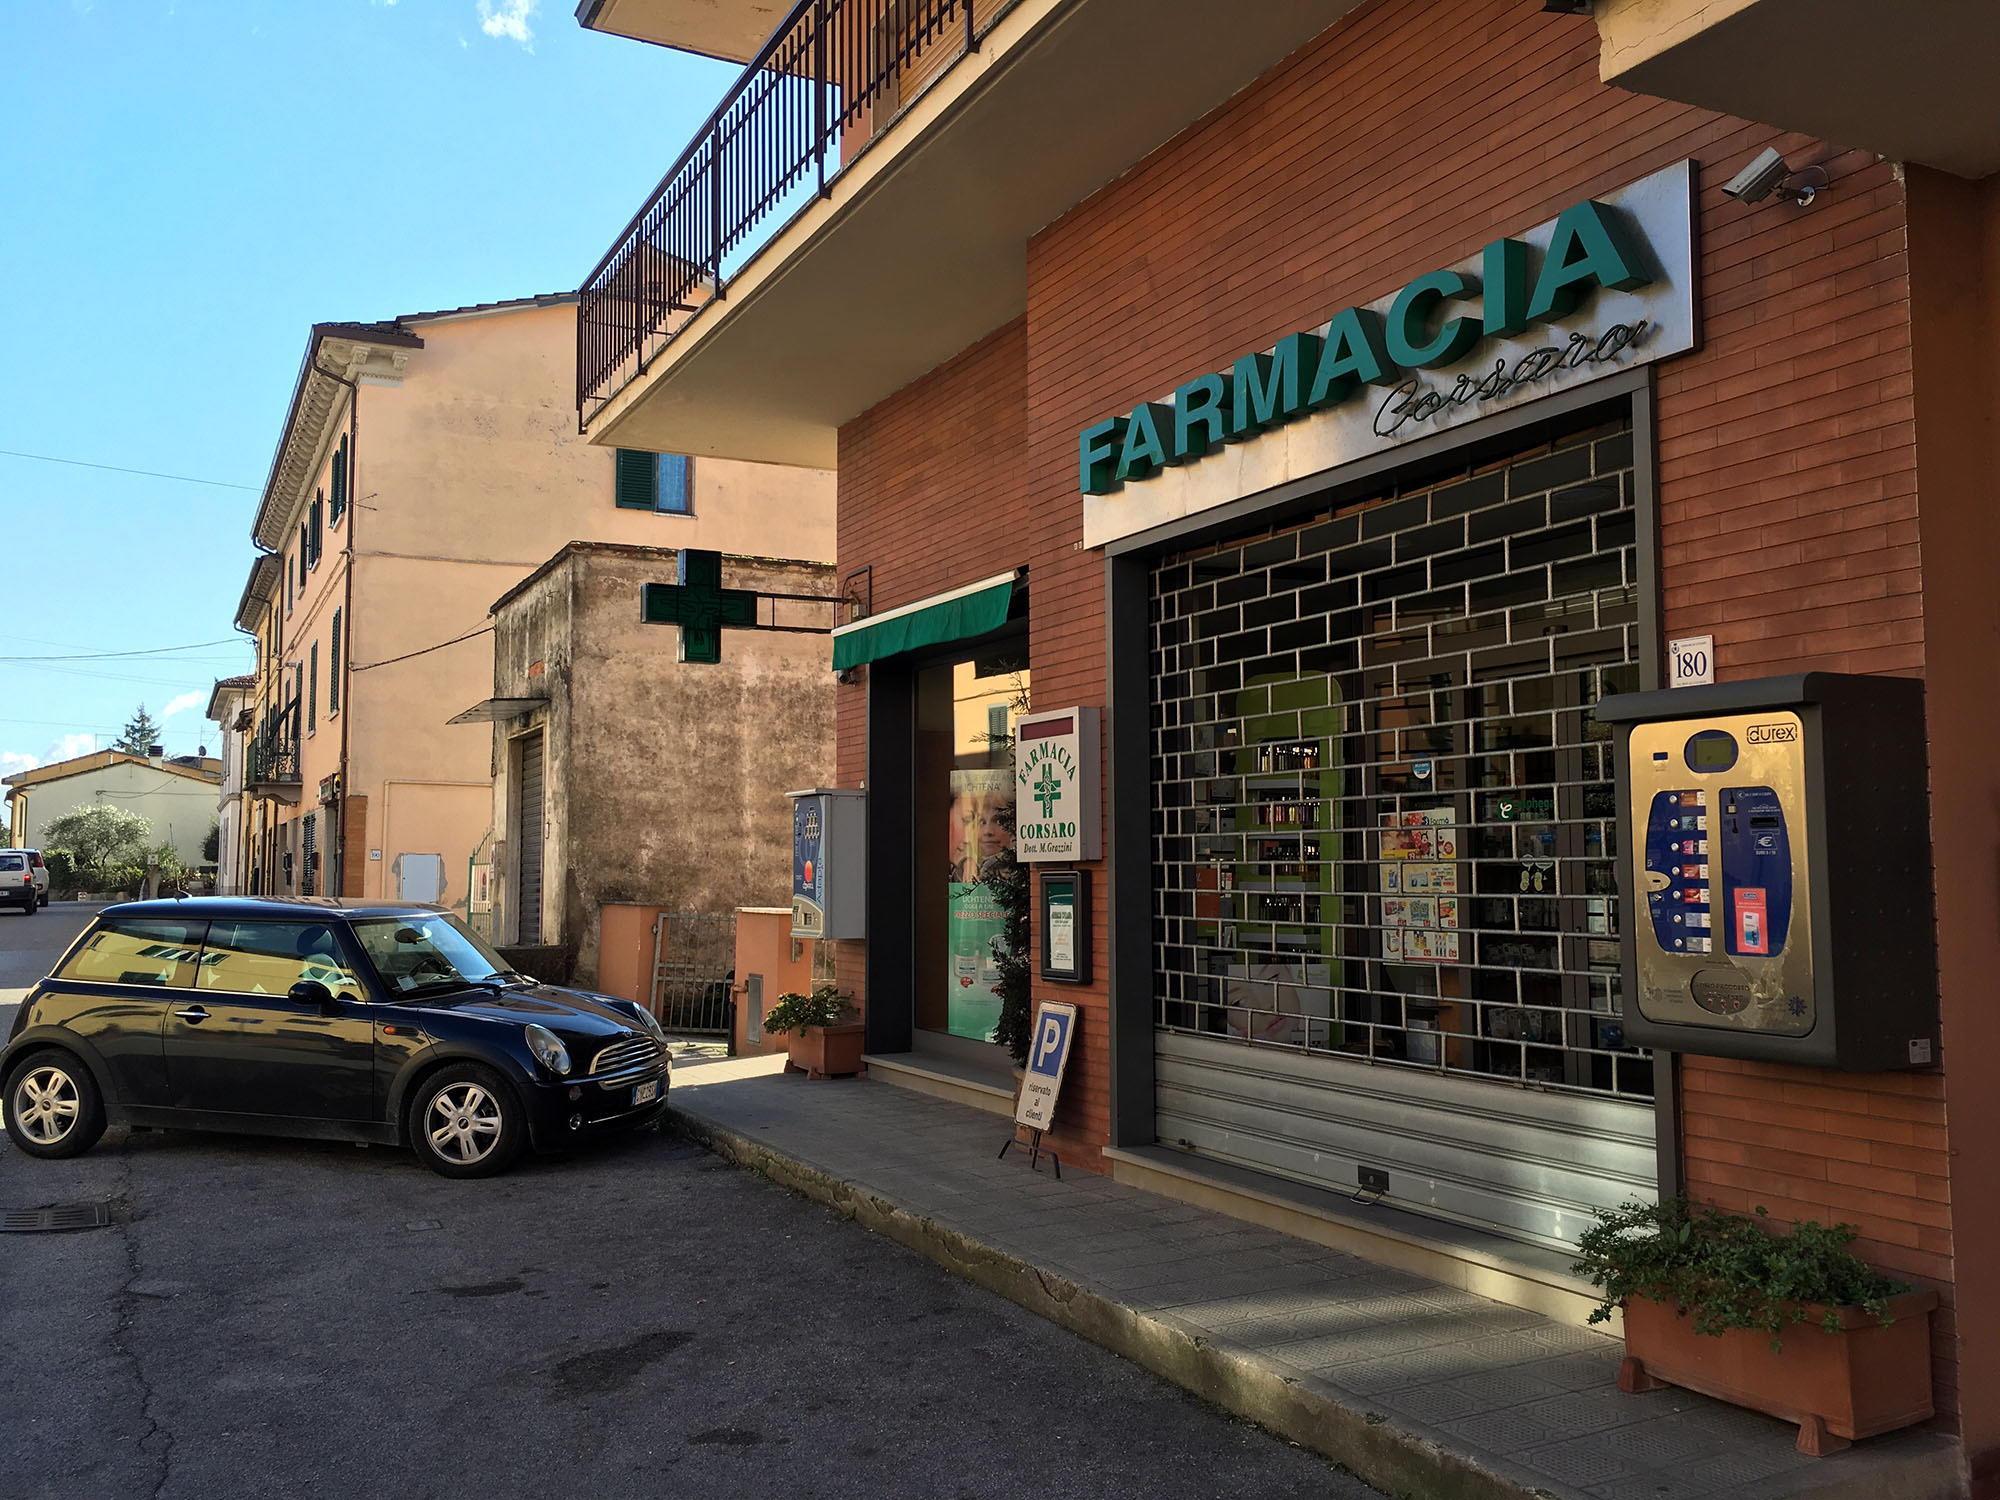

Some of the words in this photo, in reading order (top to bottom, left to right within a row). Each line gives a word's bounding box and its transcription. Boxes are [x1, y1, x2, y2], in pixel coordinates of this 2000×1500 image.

[1079, 200, 1652, 495] FARMACIA
[1373, 319, 1648, 437] Corsaro
[1676, 651, 1707, 679] 180
[1750, 726, 1795, 742] durex
[1018, 741, 1077, 785] FARMACIA
[1020, 822, 1076, 840] CORSARO
[1037, 1018, 1060, 1067] P
[1028, 1082, 1051, 1096] riservato
[1033, 1097, 1041, 1107] ai
[1025, 1109, 1042, 1121] clienti
